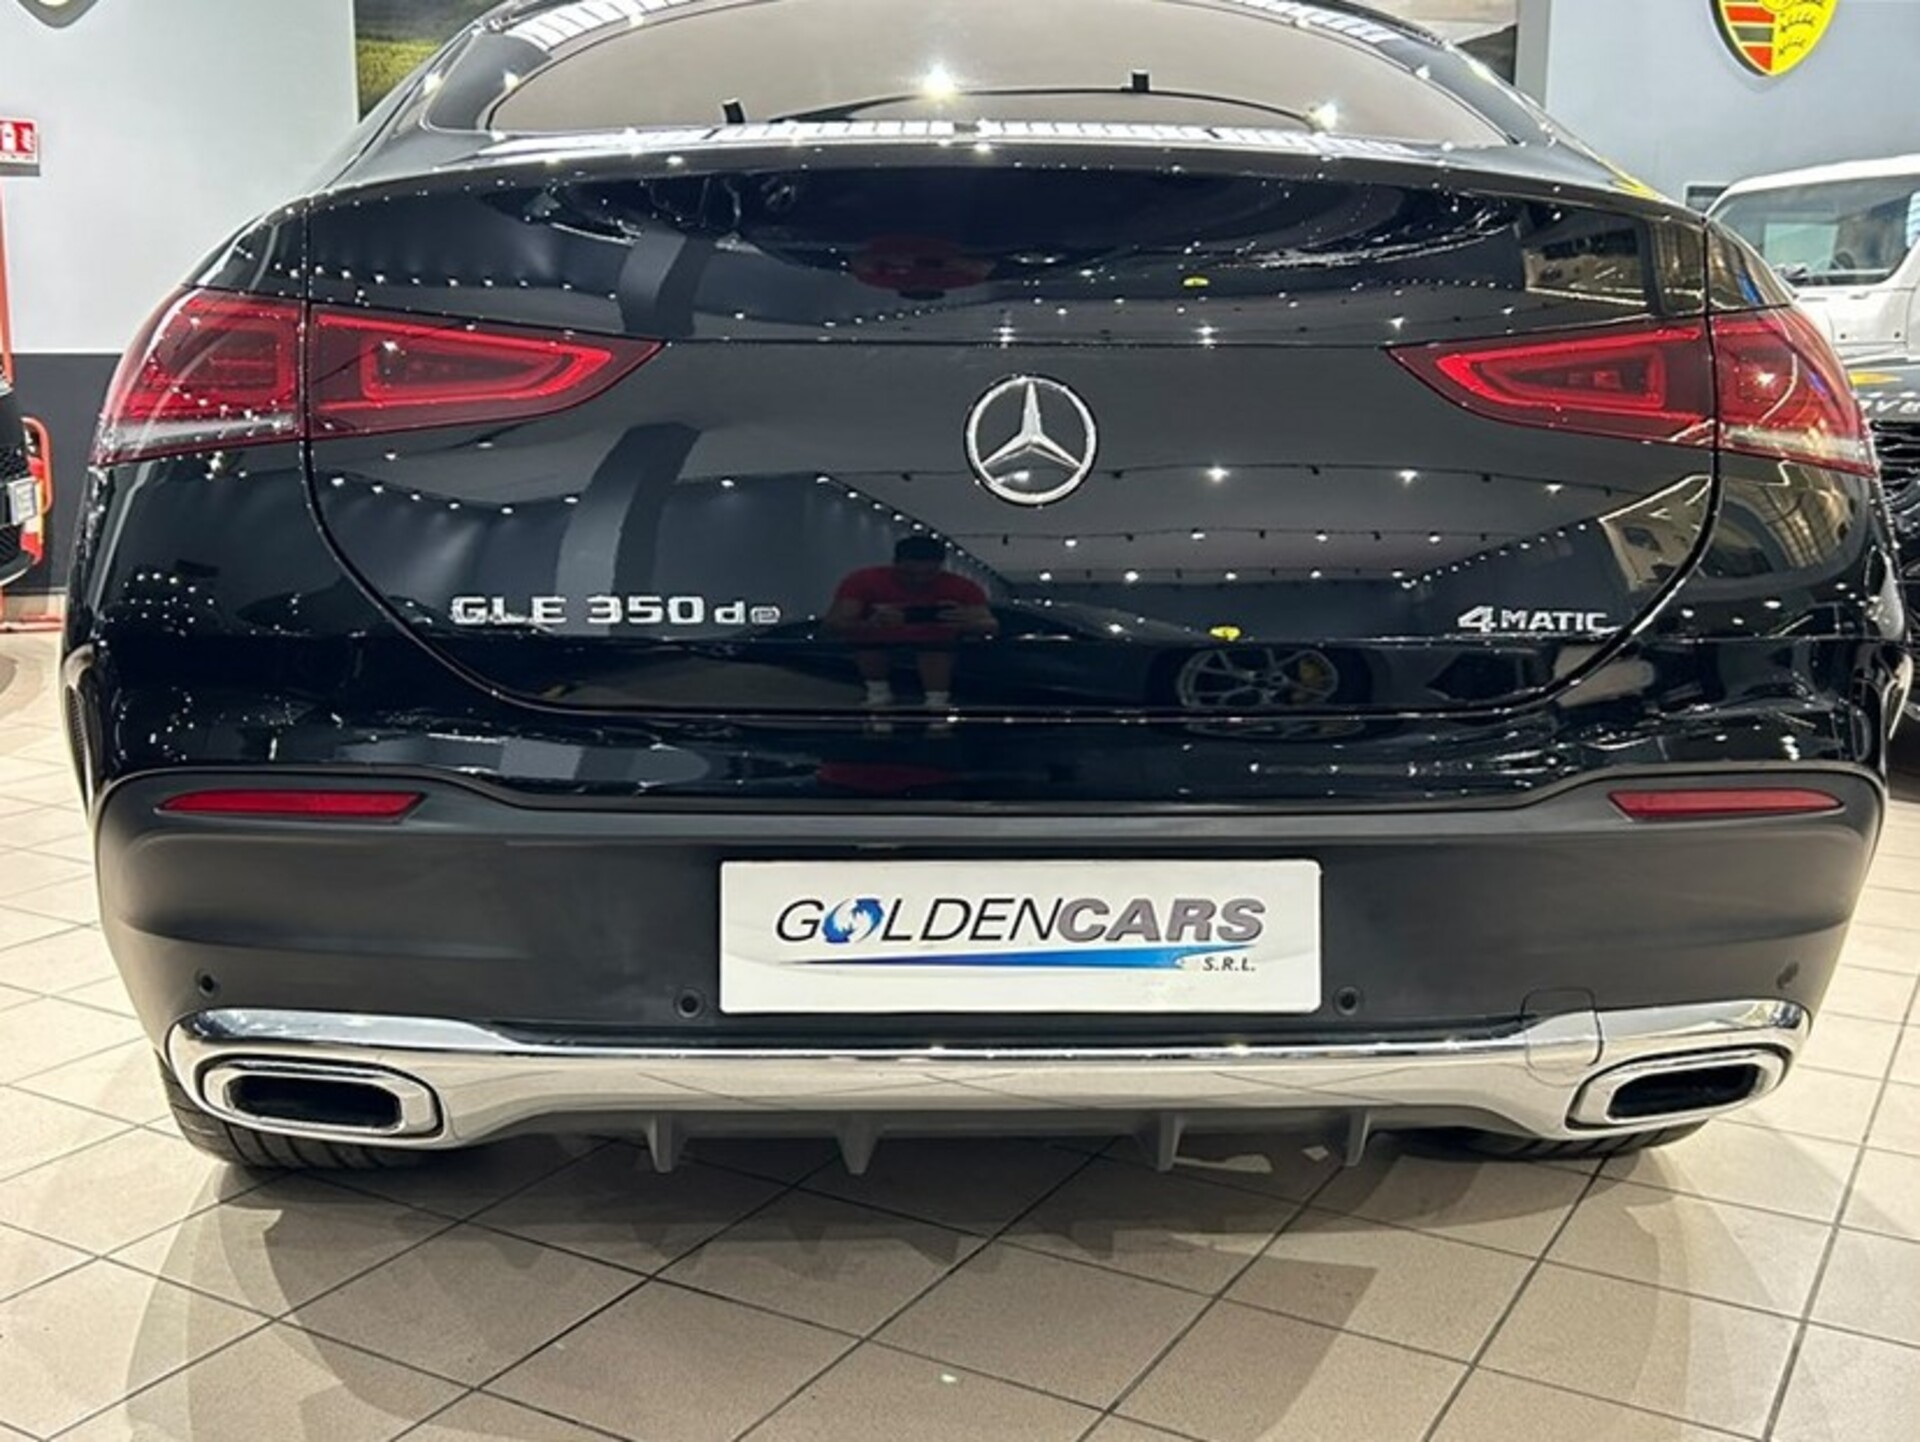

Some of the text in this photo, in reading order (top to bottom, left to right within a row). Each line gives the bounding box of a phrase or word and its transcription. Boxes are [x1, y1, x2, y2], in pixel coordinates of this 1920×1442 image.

[451, 596, 567, 624] GLE
[1457, 605, 1610, 633] 4MATIC
[1202, 956, 1257, 972] S.R.L.
